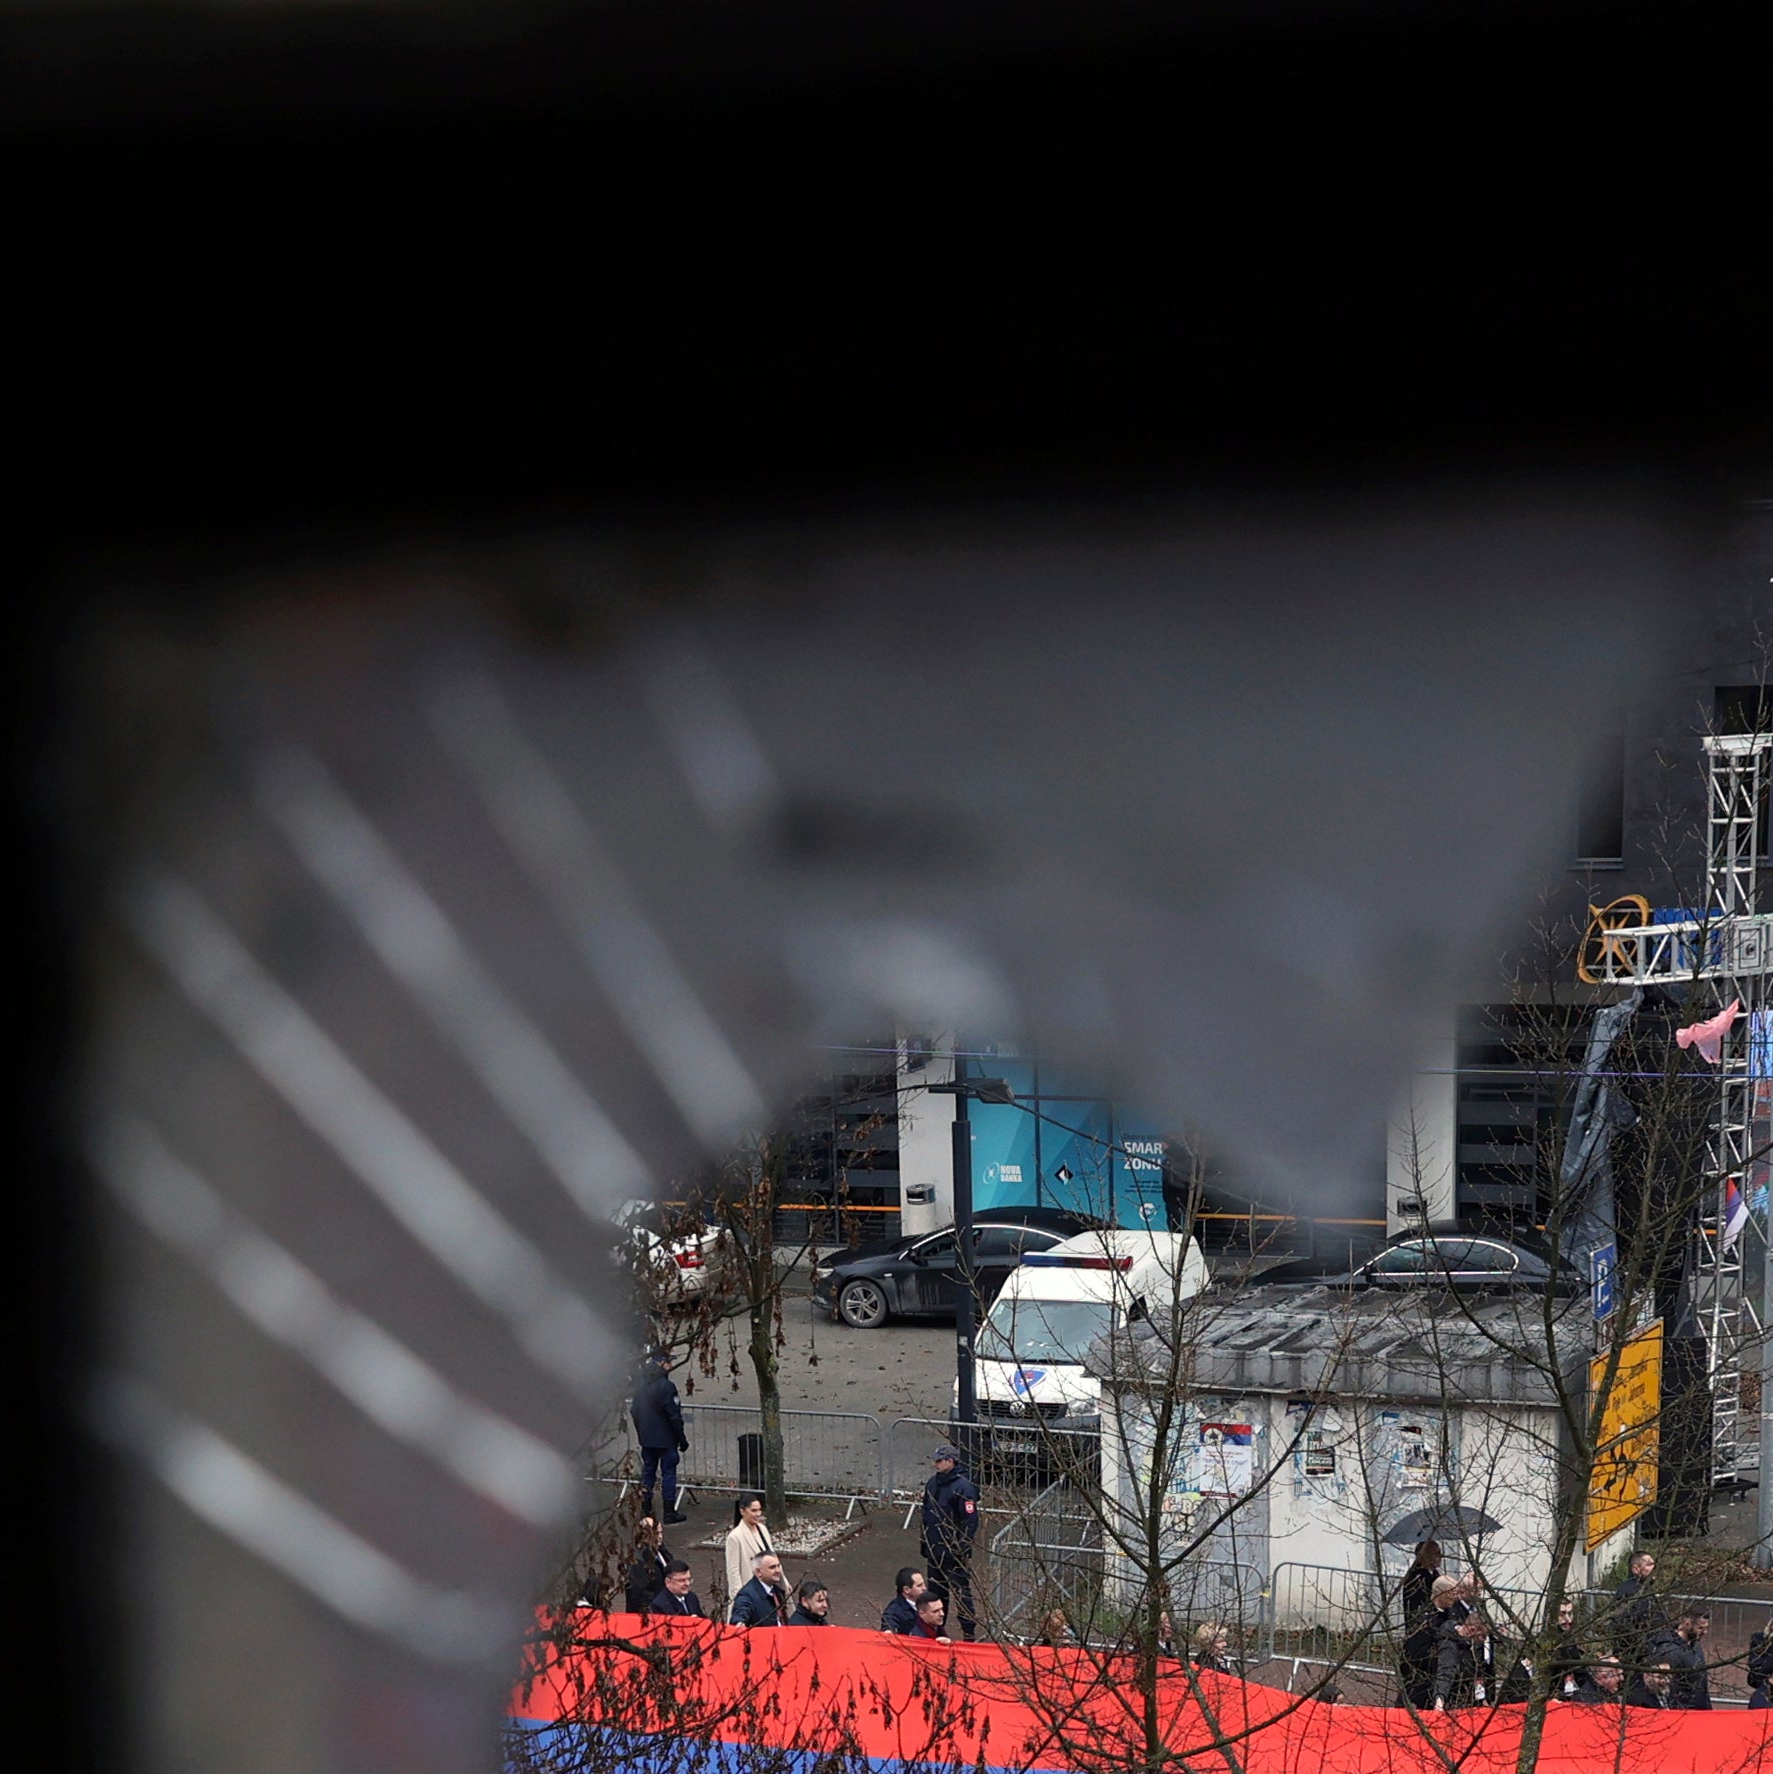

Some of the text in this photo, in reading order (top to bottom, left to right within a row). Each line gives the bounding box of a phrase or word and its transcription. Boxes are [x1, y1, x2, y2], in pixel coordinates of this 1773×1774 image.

[1124, 1142, 1163, 1155] SMAR
[1000, 1165, 1021, 1174] NOVA
[1000, 1174, 1023, 1183] BANKA
